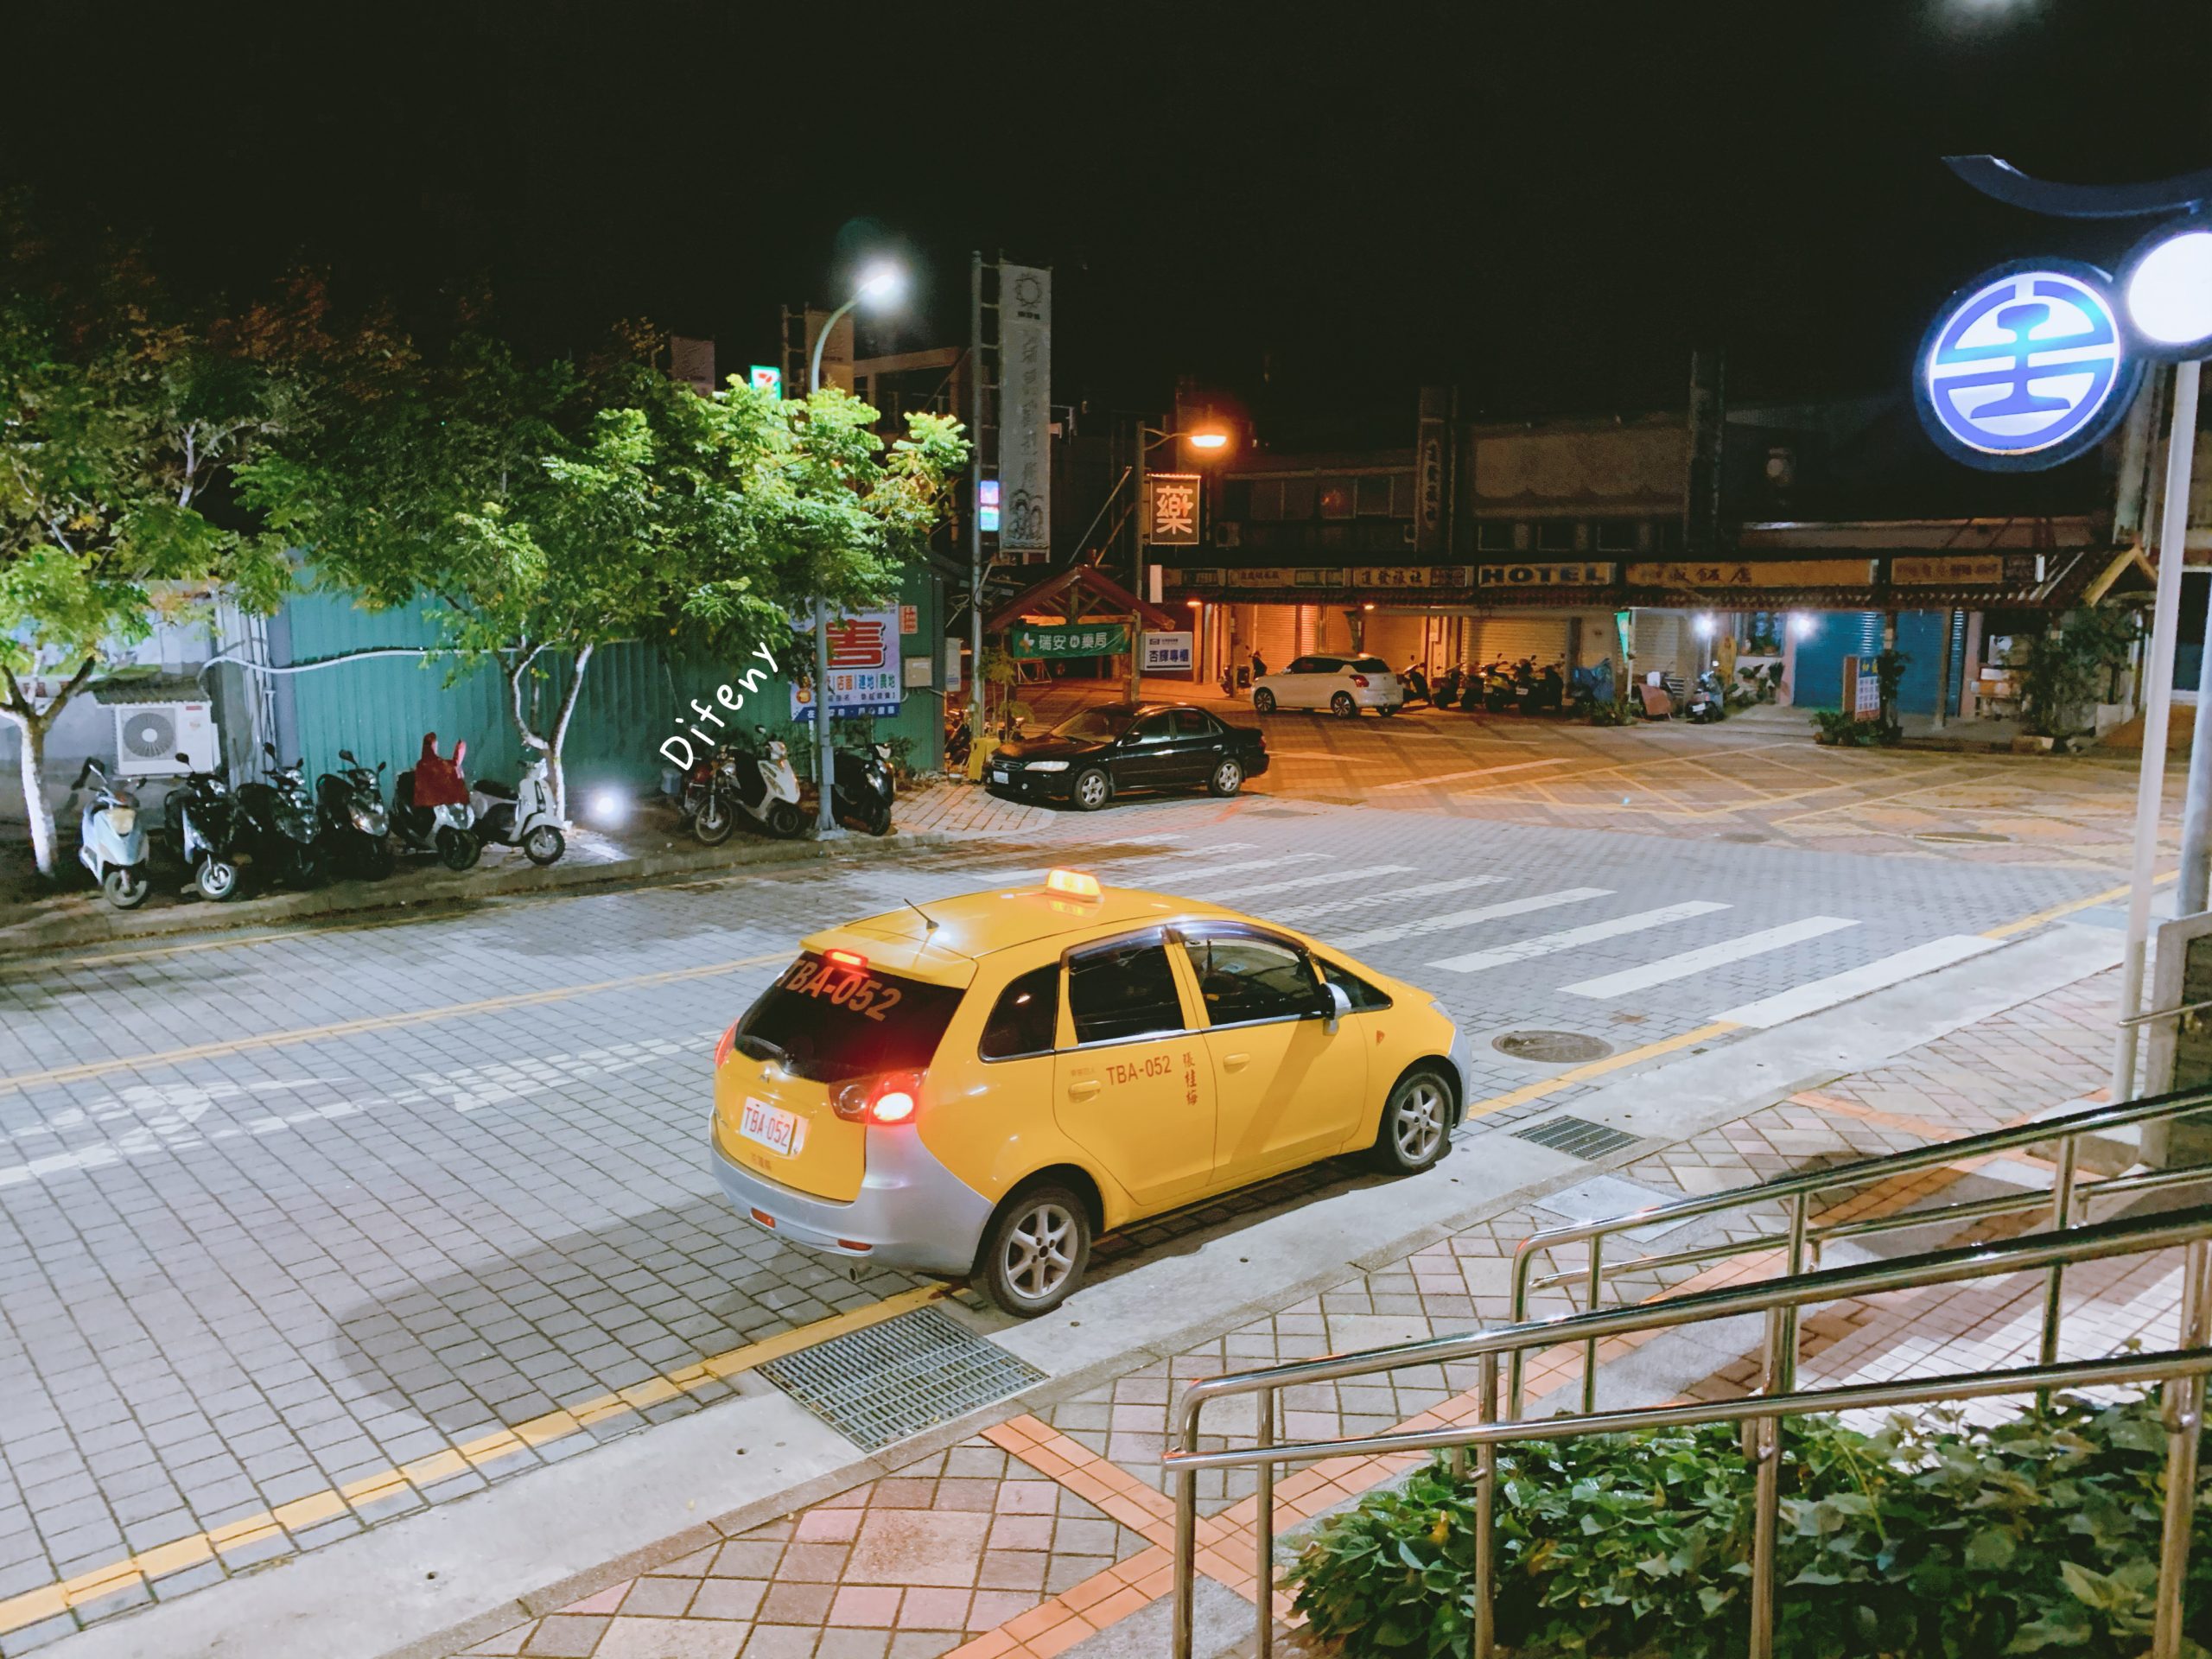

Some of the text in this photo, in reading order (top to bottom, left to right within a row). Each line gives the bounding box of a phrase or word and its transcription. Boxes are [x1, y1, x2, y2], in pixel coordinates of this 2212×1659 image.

[1156, 485, 1194, 535] 藥
[1481, 566, 1605, 584] HOTEL
[776, 959, 901, 1021] TBA-052
[1106, 1055, 1172, 1086] TBA-052
